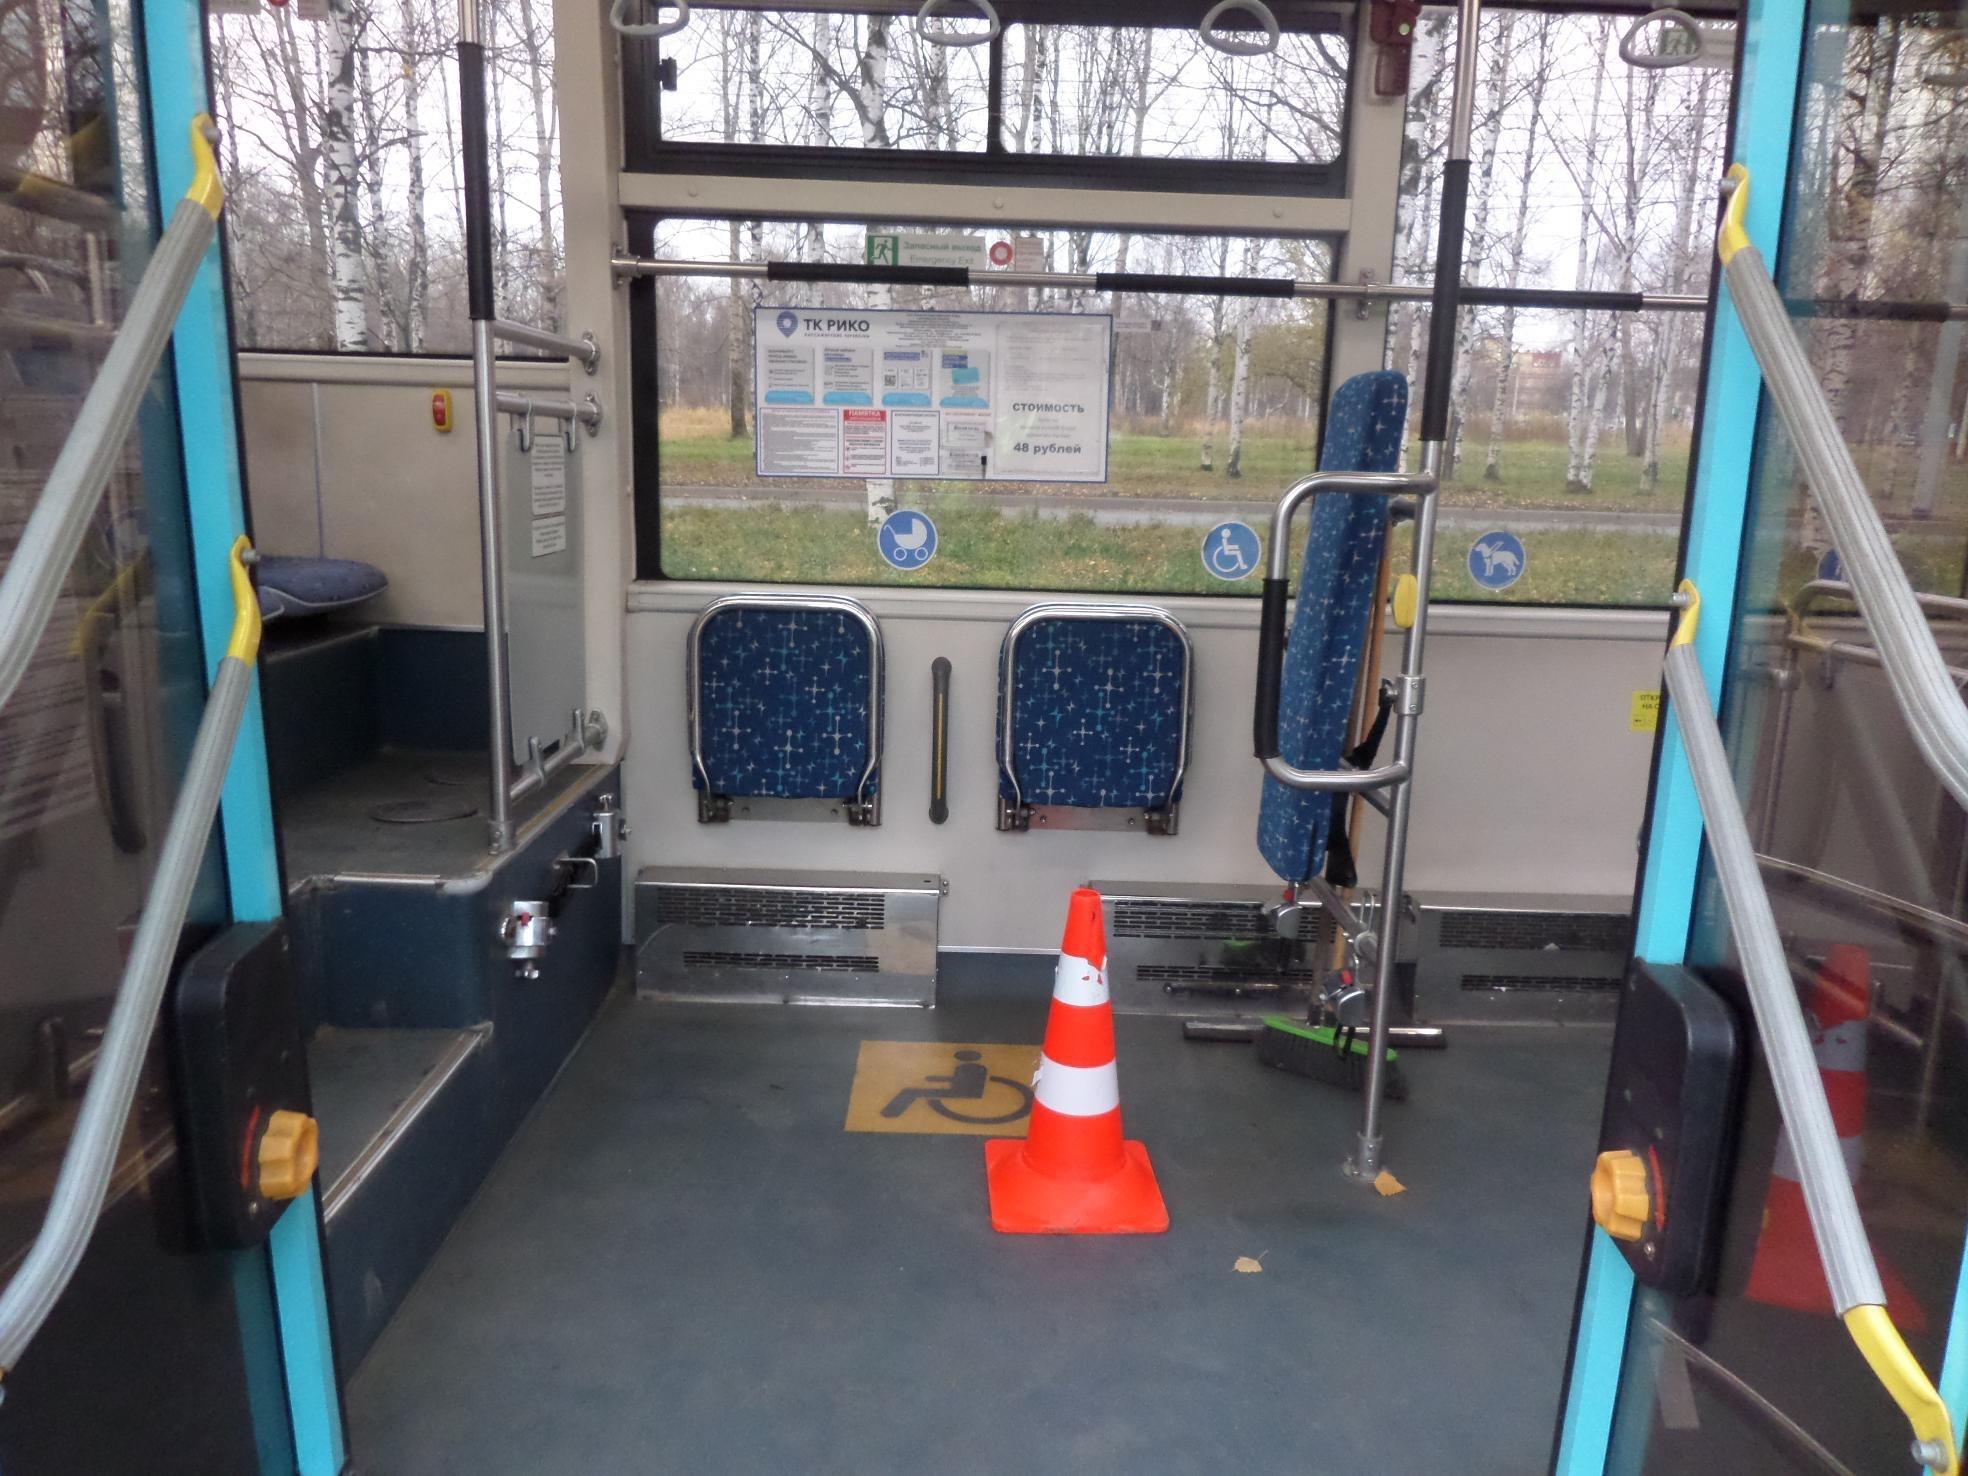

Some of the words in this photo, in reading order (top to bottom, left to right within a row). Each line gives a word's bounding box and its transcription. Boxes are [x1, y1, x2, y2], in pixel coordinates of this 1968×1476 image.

[910, 255, 955, 265] Emergency
[958, 256, 974, 265] Exit
[804, 319, 822, 331] ТК
[827, 320, 870, 332] РИКО
[1012, 402, 1085, 413] СТОИМОСТЬ
[1013, 443, 1029, 453] 48
[1033, 443, 1081, 455] рублей
